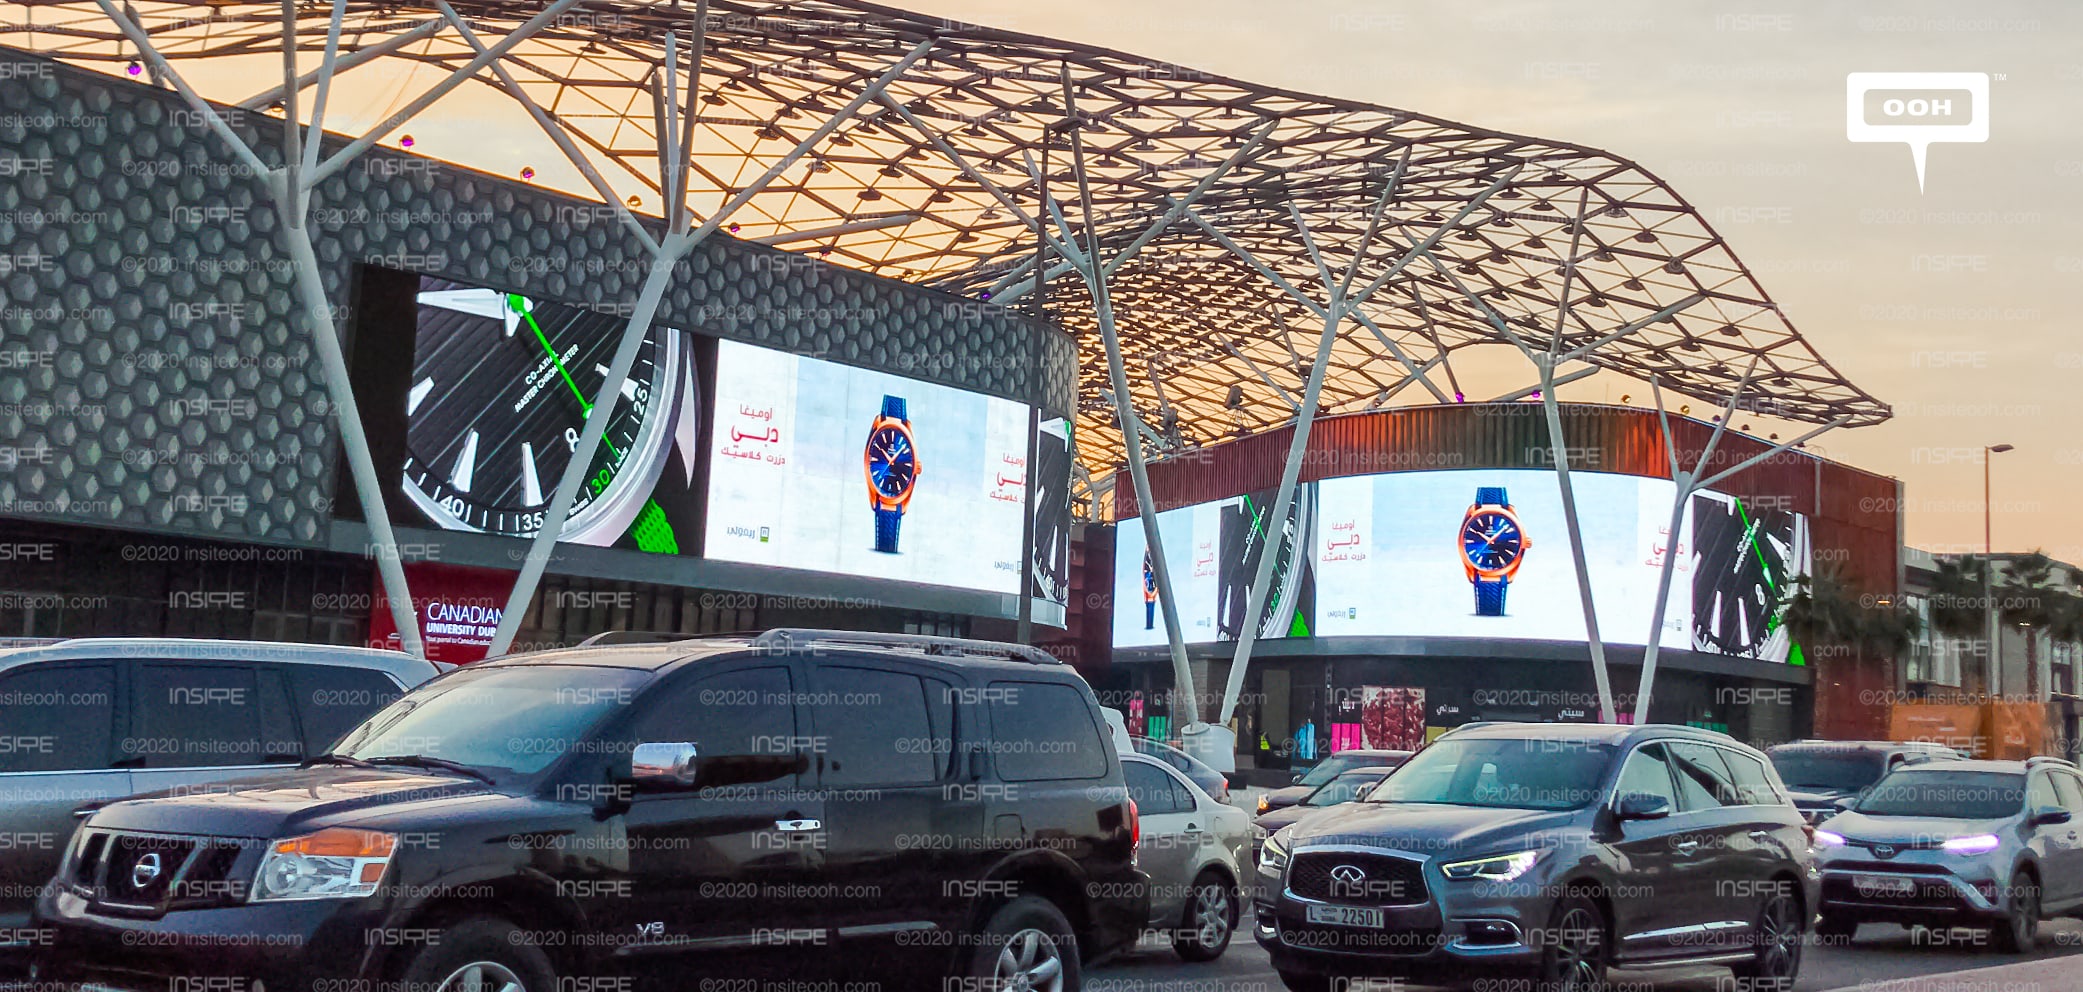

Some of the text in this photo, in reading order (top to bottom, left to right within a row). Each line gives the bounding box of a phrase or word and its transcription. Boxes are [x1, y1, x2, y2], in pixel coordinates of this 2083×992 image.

[514, 344, 579, 413] MASTER CHRONMETER
[525, 350, 559, 385] CO-AXIL
[633, 388, 648, 416] 25
[731, 425, 779, 448] دبي
[591, 469, 611, 494] 30
[440, 495, 464, 517] 40
[522, 512, 544, 531] 35
[1327, 533, 1360, 554] دبي
[427, 602, 502, 625] CANADIAN
[426, 622, 496, 637] UNIVERSITY DUB
[635, 921, 665, 935] V8
[1341, 907, 1380, 927] 22501
